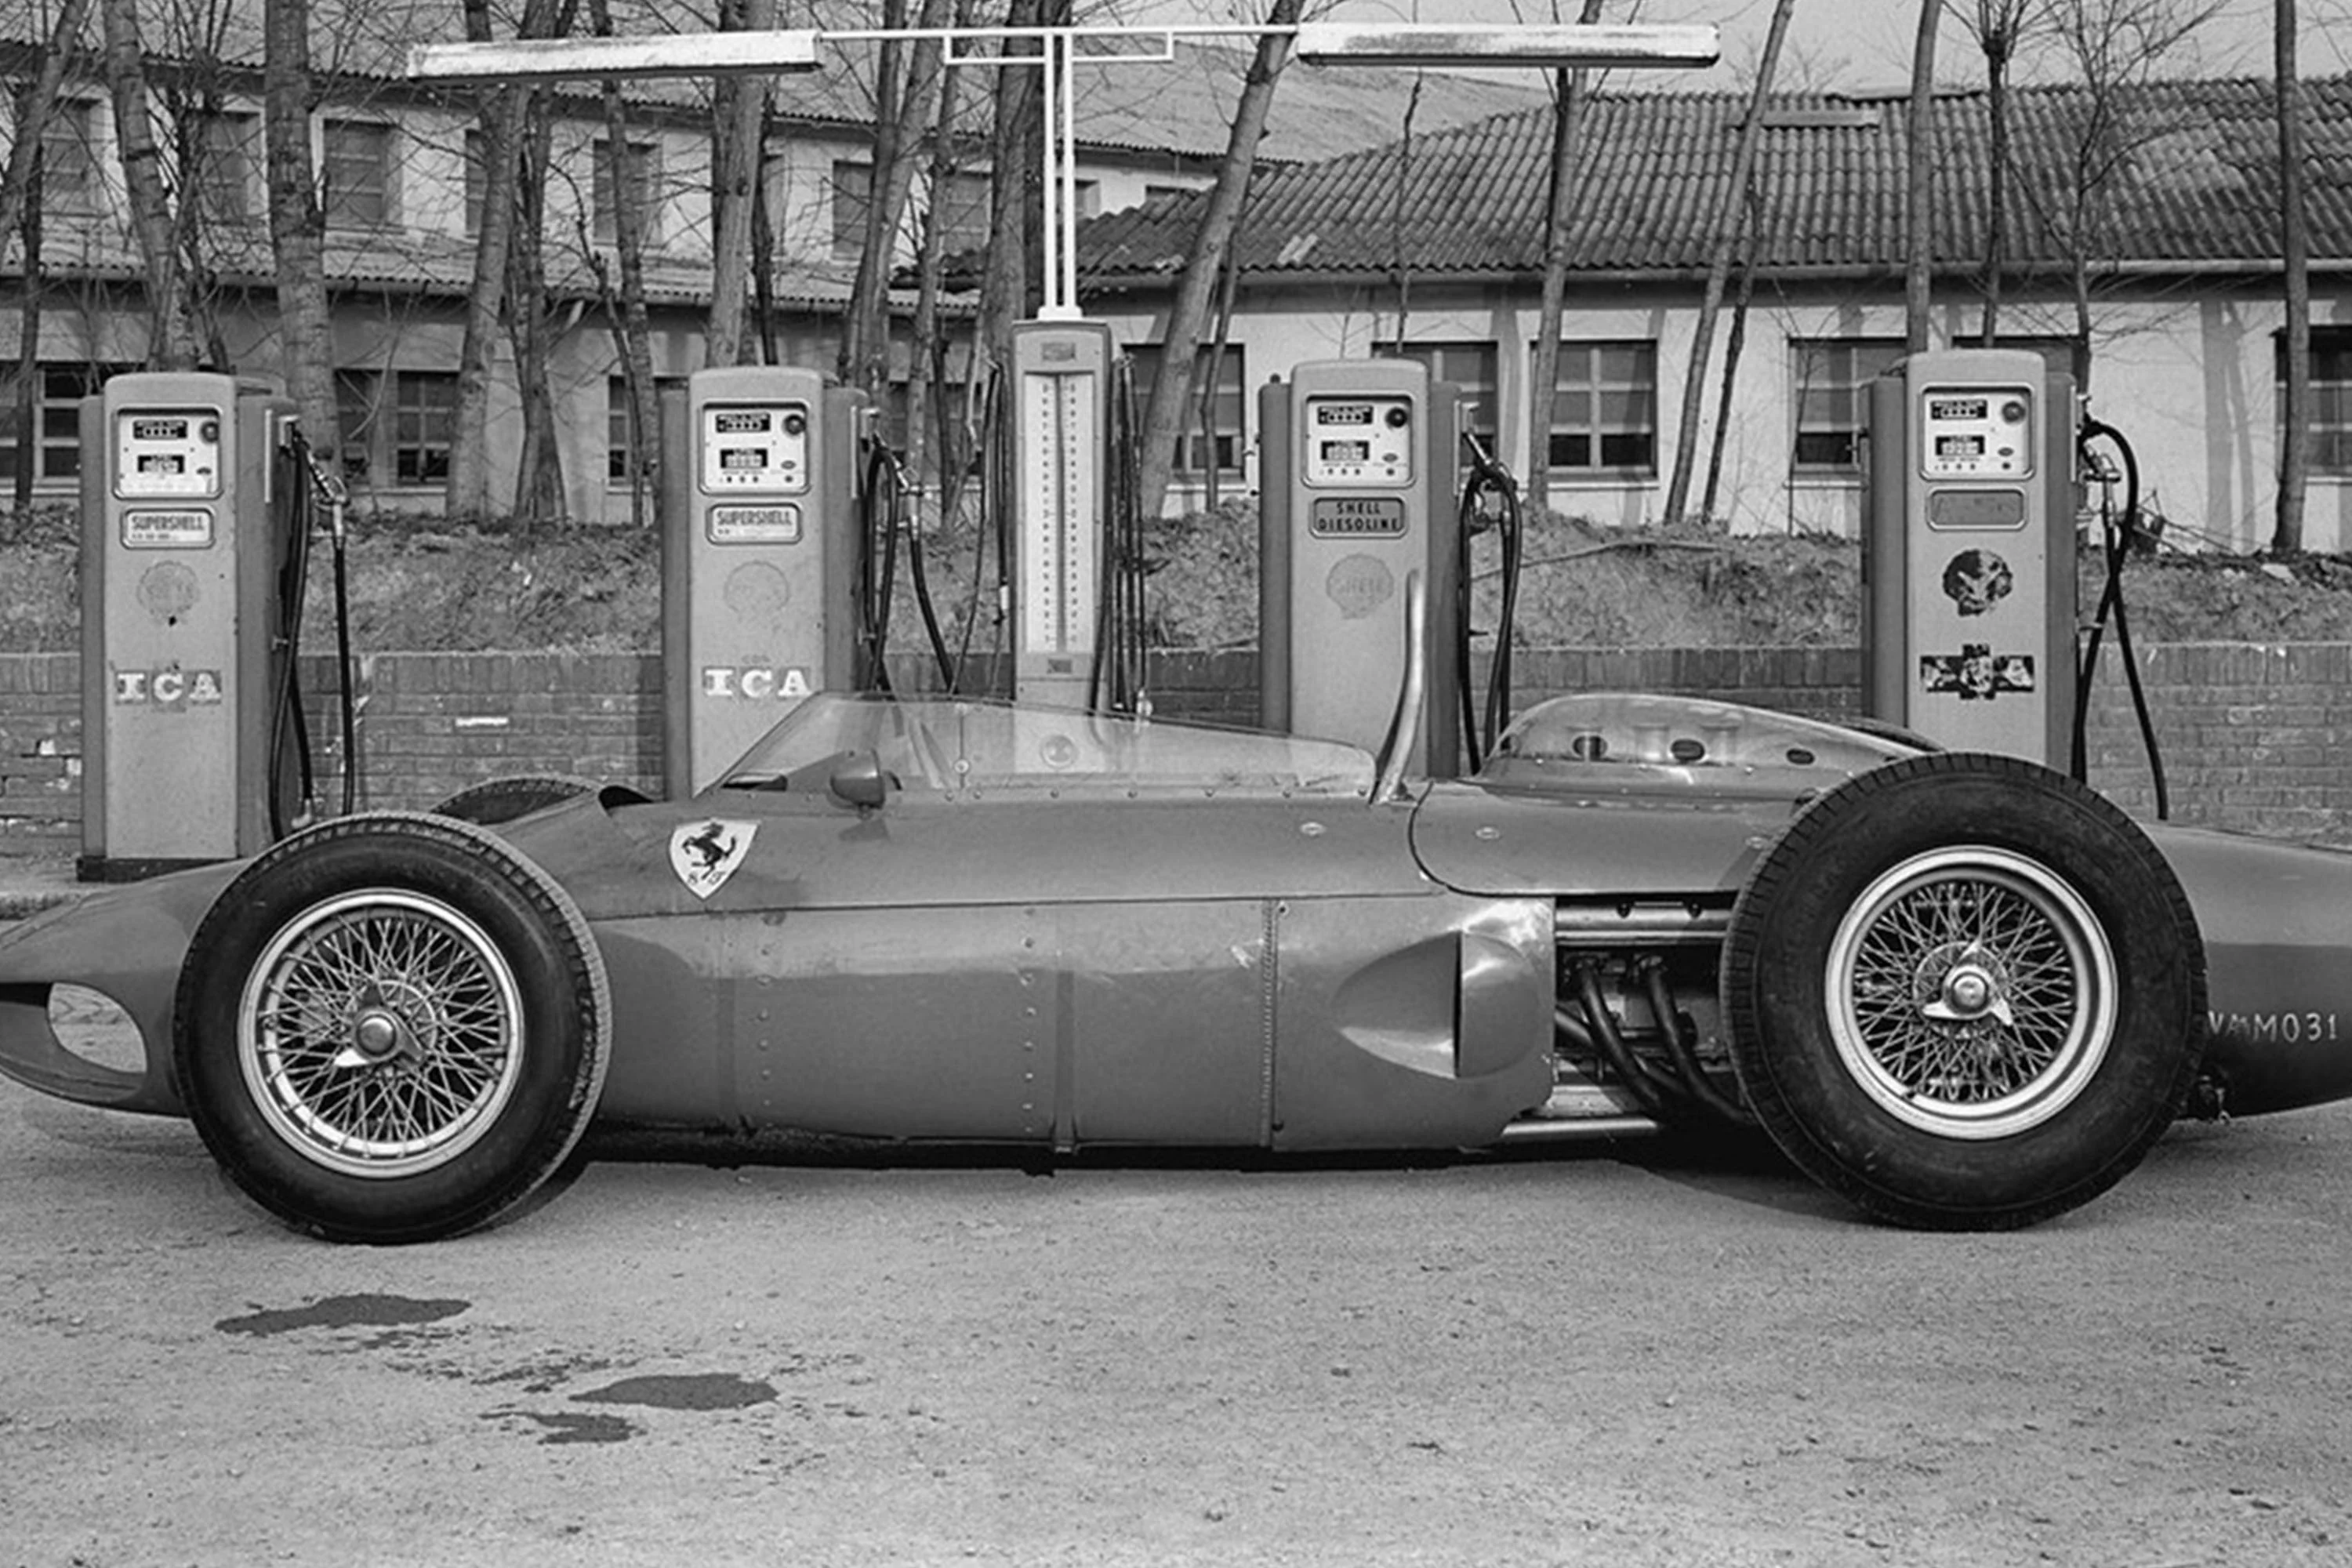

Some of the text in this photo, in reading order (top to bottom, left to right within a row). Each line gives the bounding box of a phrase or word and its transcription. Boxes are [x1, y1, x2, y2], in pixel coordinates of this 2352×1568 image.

[1337, 502, 1381, 514] SHELL
[132, 515, 204, 531] SUPERSHELL
[717, 510, 792, 525] SUPERSHELL
[1319, 517, 1399, 531] DIESOLINE
[117, 673, 222, 702] ICA
[705, 670, 811, 698] ICA
